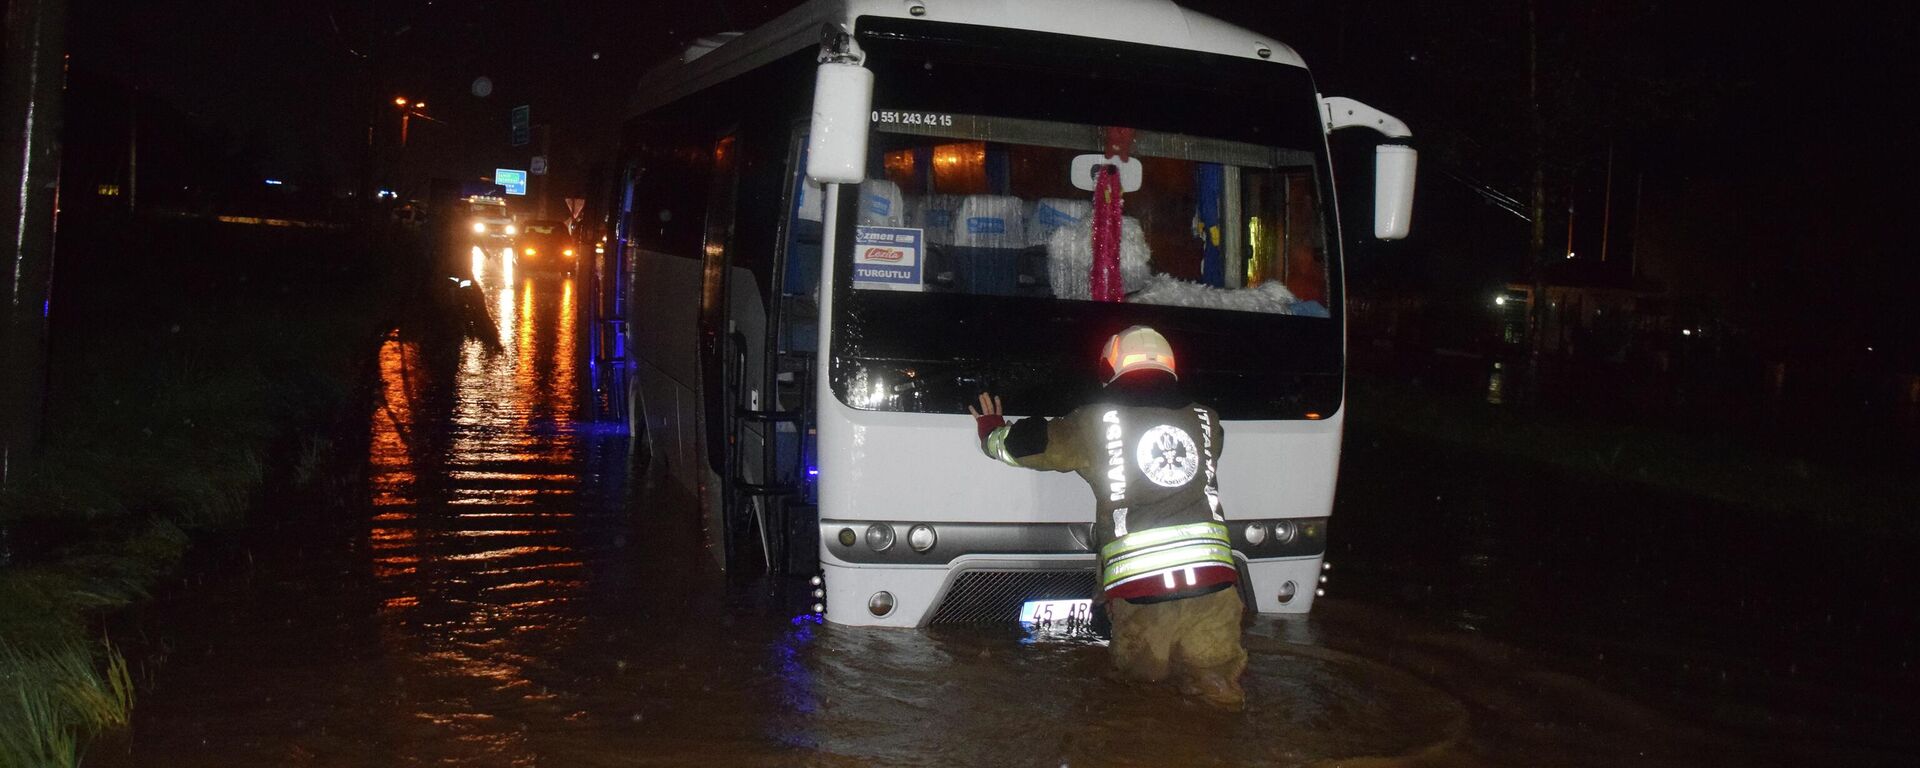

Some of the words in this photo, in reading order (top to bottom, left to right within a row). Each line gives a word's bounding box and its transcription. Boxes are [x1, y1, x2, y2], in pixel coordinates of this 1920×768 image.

[872, 111, 879, 122] 0
[881, 112, 900, 123] 551
[902, 113, 922, 125] 243
[924, 114, 937, 126] 42
[940, 115, 952, 127] 15
[858, 269, 911, 279] TURGUTLU
[1033, 603, 1054, 626] 45
